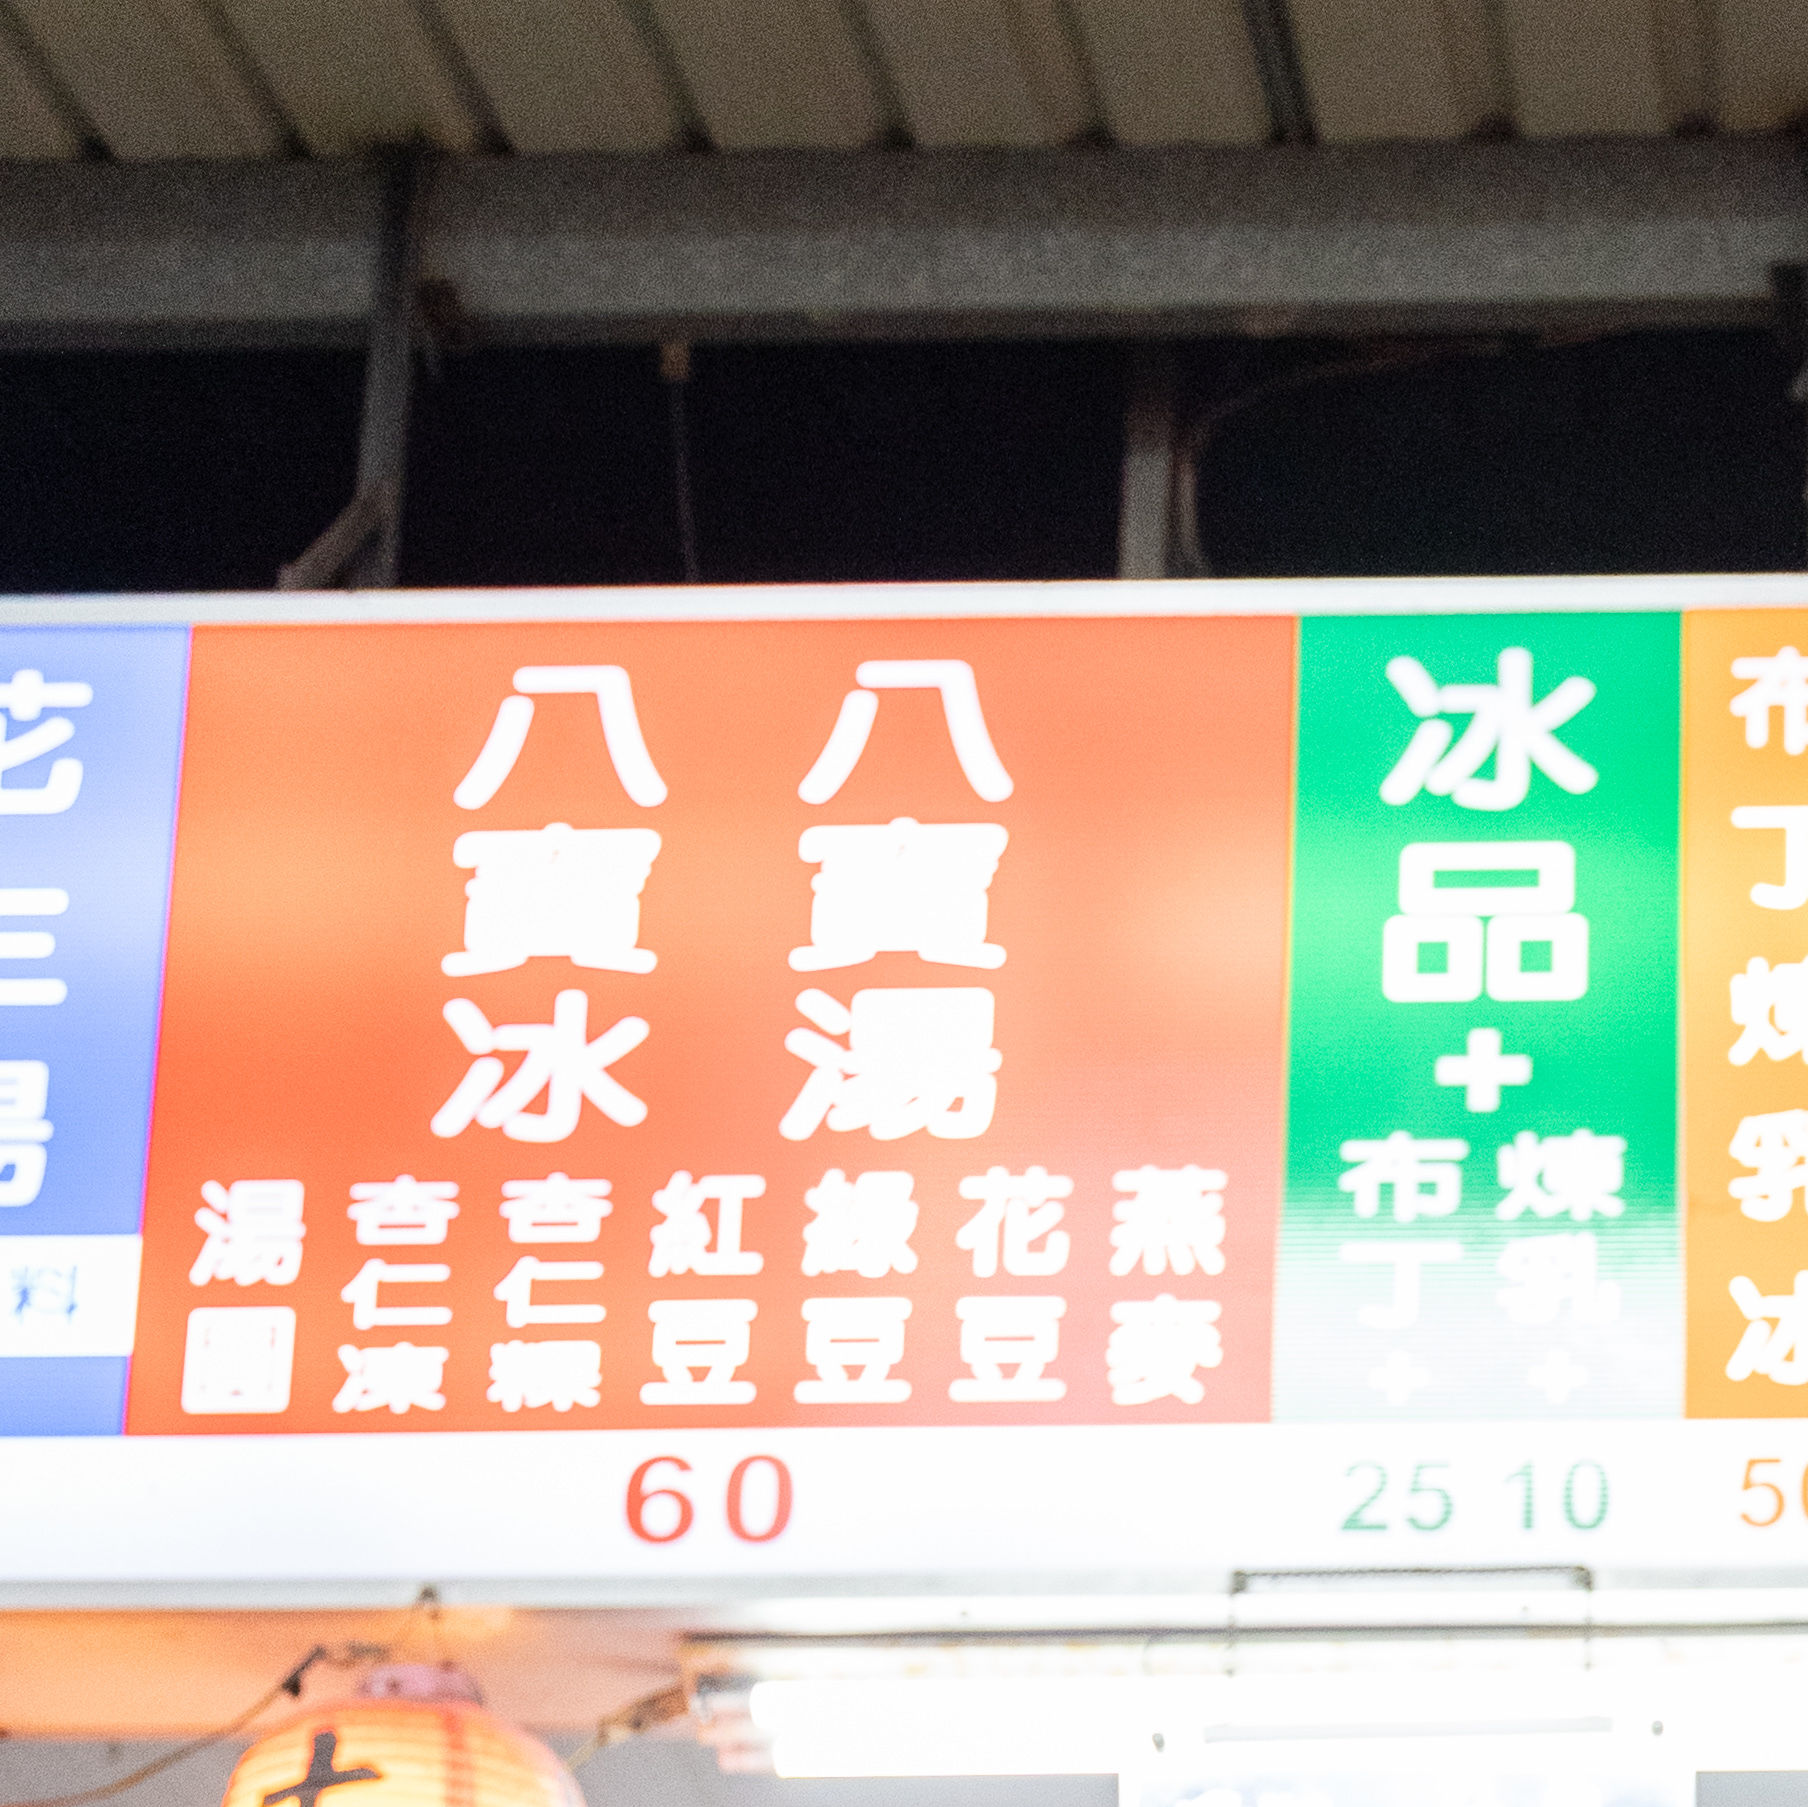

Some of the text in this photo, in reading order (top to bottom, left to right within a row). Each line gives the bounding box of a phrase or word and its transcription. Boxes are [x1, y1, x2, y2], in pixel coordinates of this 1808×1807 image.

[431, 664, 668, 1143] 八寶冰
[780, 660, 1014, 1141] 八寶湯
[181, 1179, 305, 1415] 湯圓
[640, 1171, 766, 1405] 紅豆
[794, 1169, 920, 1403] 綠豆
[949, 1164, 1075, 1401] 花豆
[1106, 1163, 1228, 1405] 燕麥
[624, 1454, 794, 1543] 60
[1340, 1459, 1455, 1533] 25
[1503, 1458, 1611, 1532] 10
